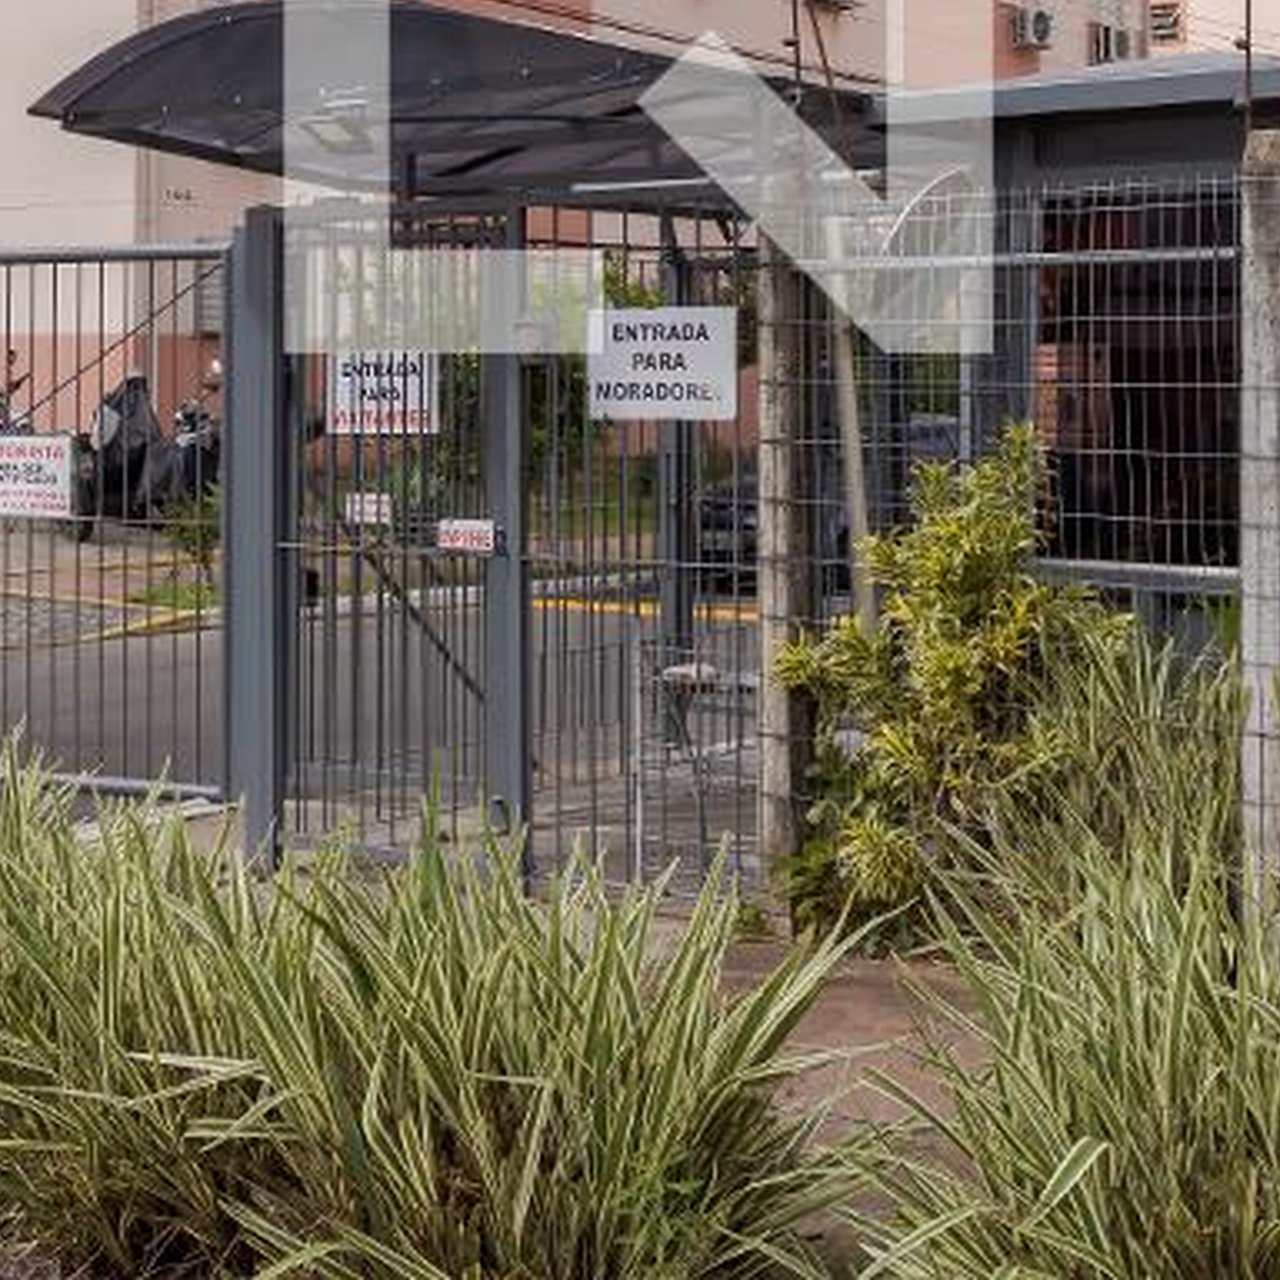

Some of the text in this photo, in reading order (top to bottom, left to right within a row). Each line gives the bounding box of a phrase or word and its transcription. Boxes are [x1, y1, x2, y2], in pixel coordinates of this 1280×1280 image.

[613, 323, 710, 342] ENTRADA
[631, 352, 687, 371] PARA
[595, 382, 721, 401] MORADORE
